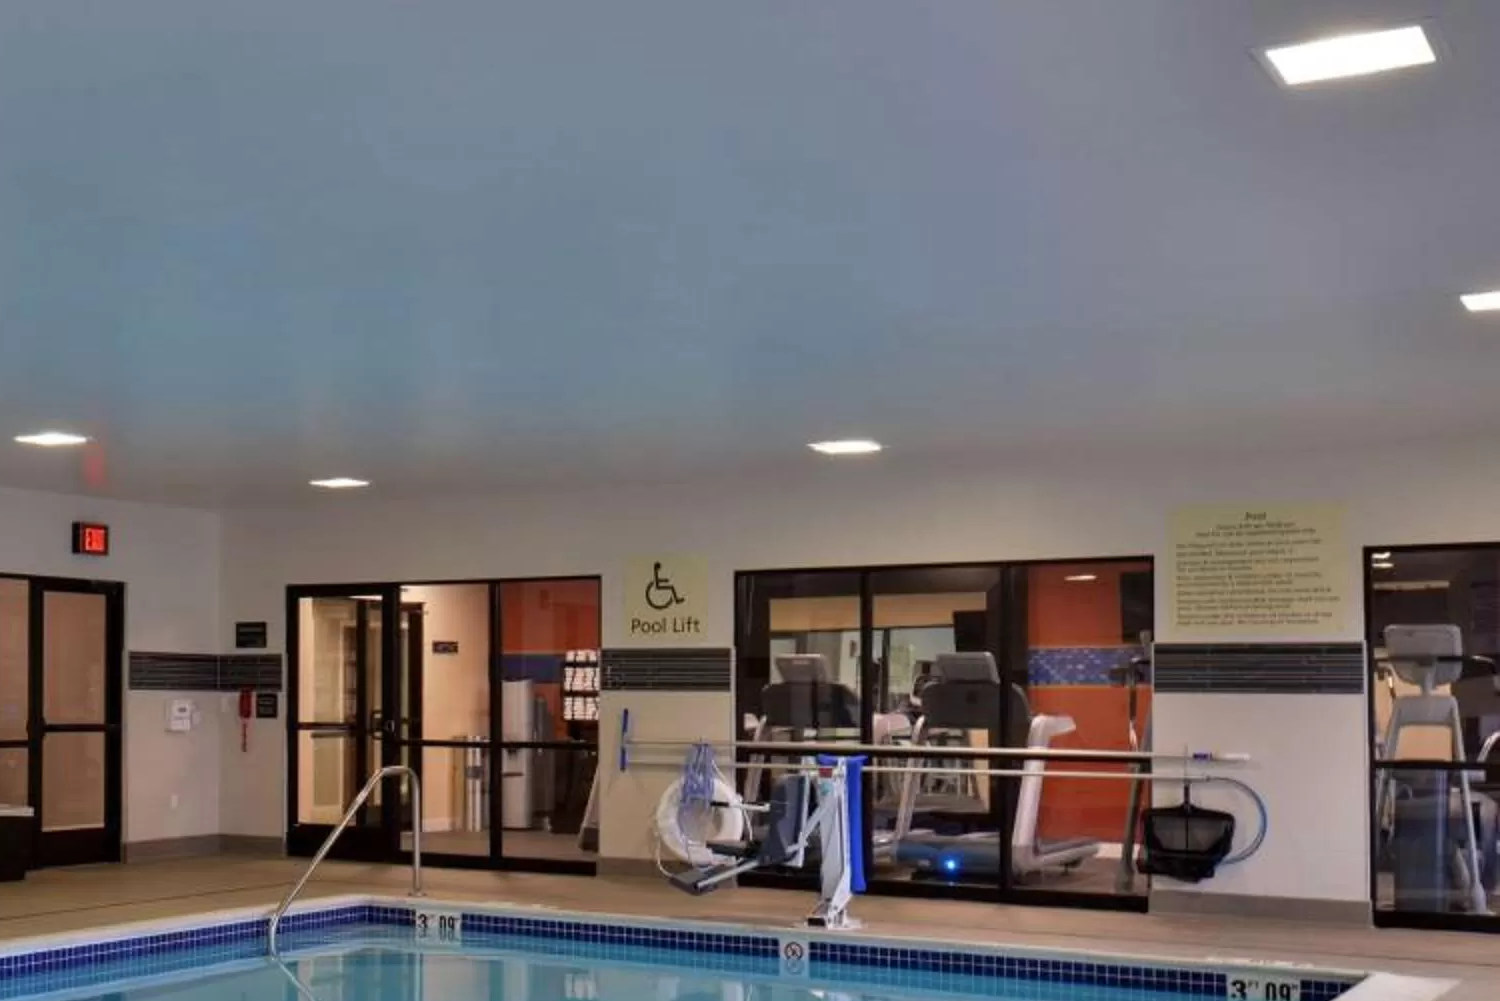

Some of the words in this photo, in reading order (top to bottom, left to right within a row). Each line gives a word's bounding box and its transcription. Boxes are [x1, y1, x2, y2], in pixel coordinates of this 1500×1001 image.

[631, 617, 667, 634] Pool
[673, 616, 701, 633] Lift
[1231, 980, 1247, 1001] 3
